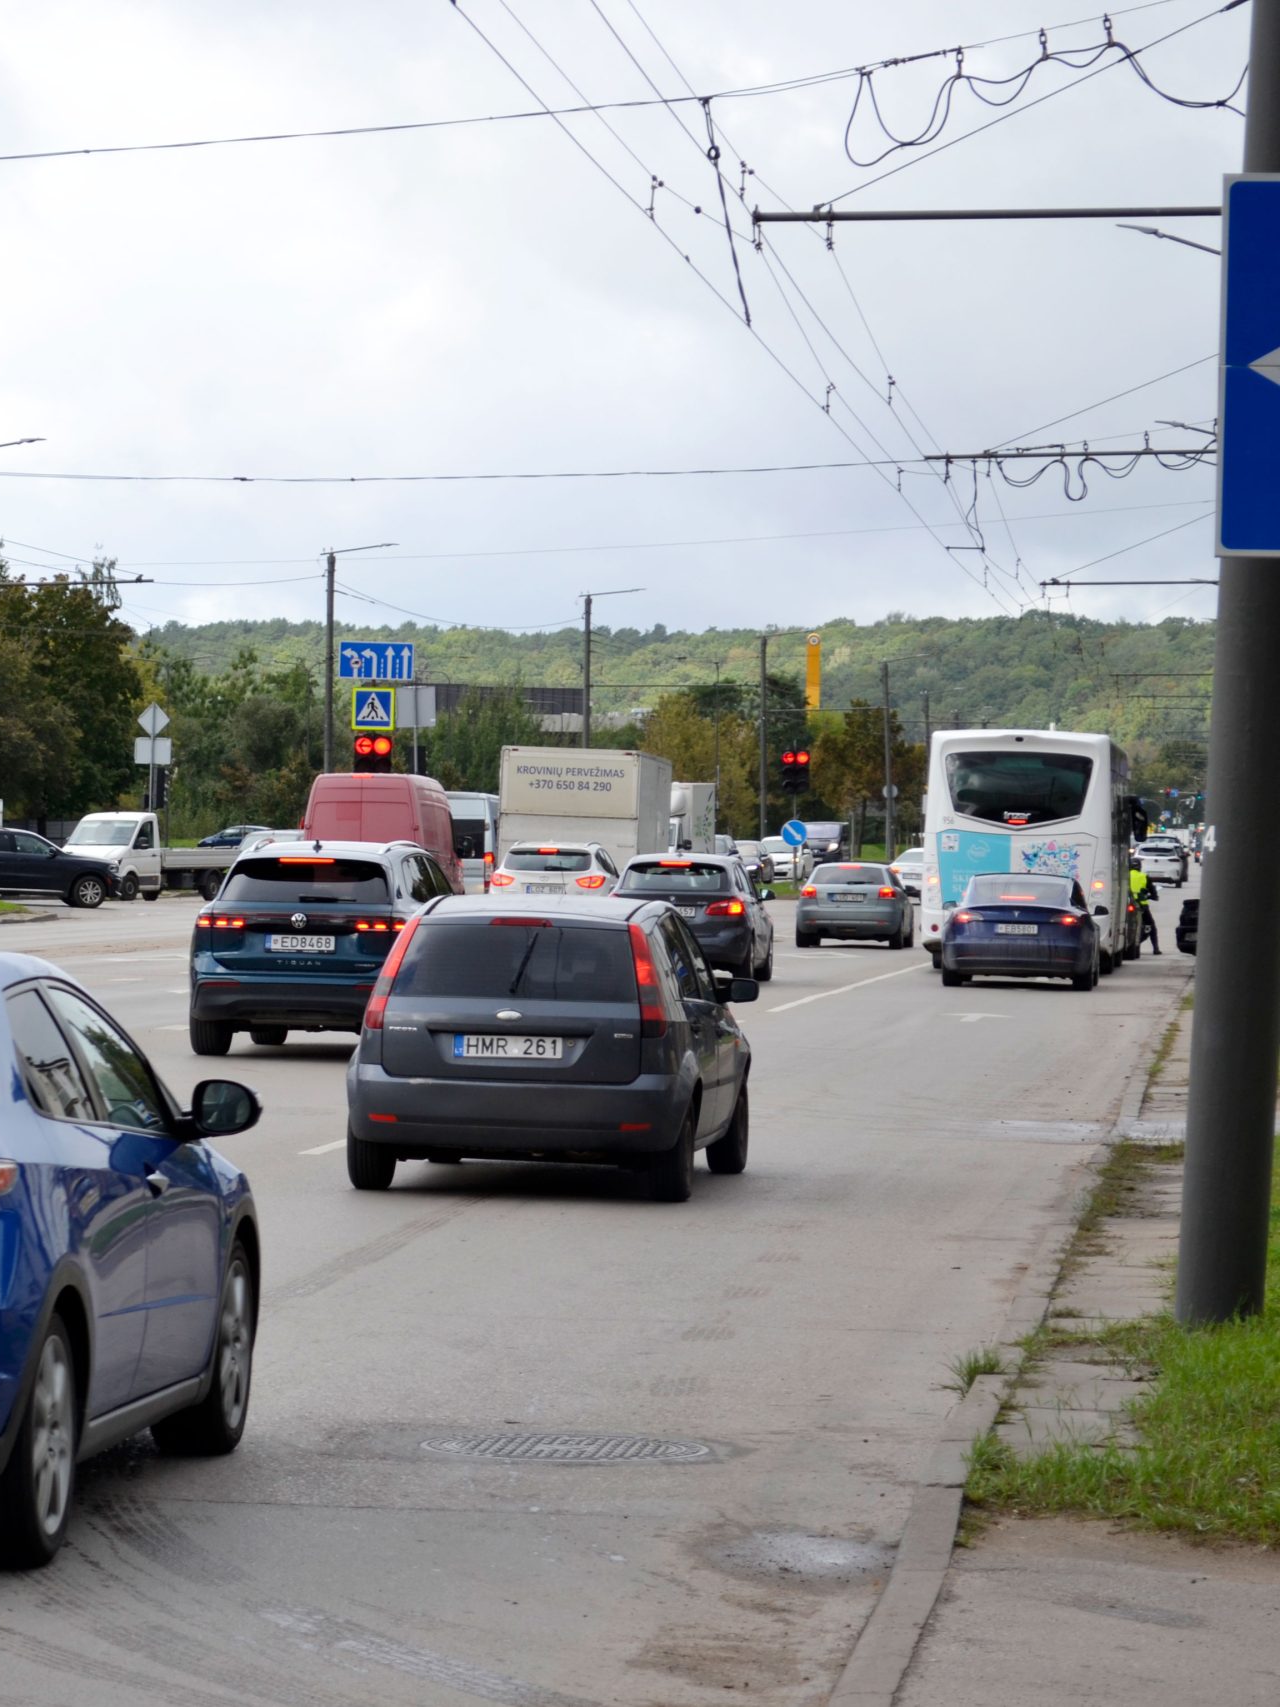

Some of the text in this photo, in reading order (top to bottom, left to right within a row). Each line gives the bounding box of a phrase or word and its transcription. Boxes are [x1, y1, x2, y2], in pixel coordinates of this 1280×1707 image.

[517, 765, 625, 778] KROVINIŲ PERVEŽIMAS
[528, 779, 612, 792] +370 650 84 290
[280, 935, 332, 949] ED8468
[466, 1037, 508, 1055] HMR
[523, 1038, 557, 1056] 261
